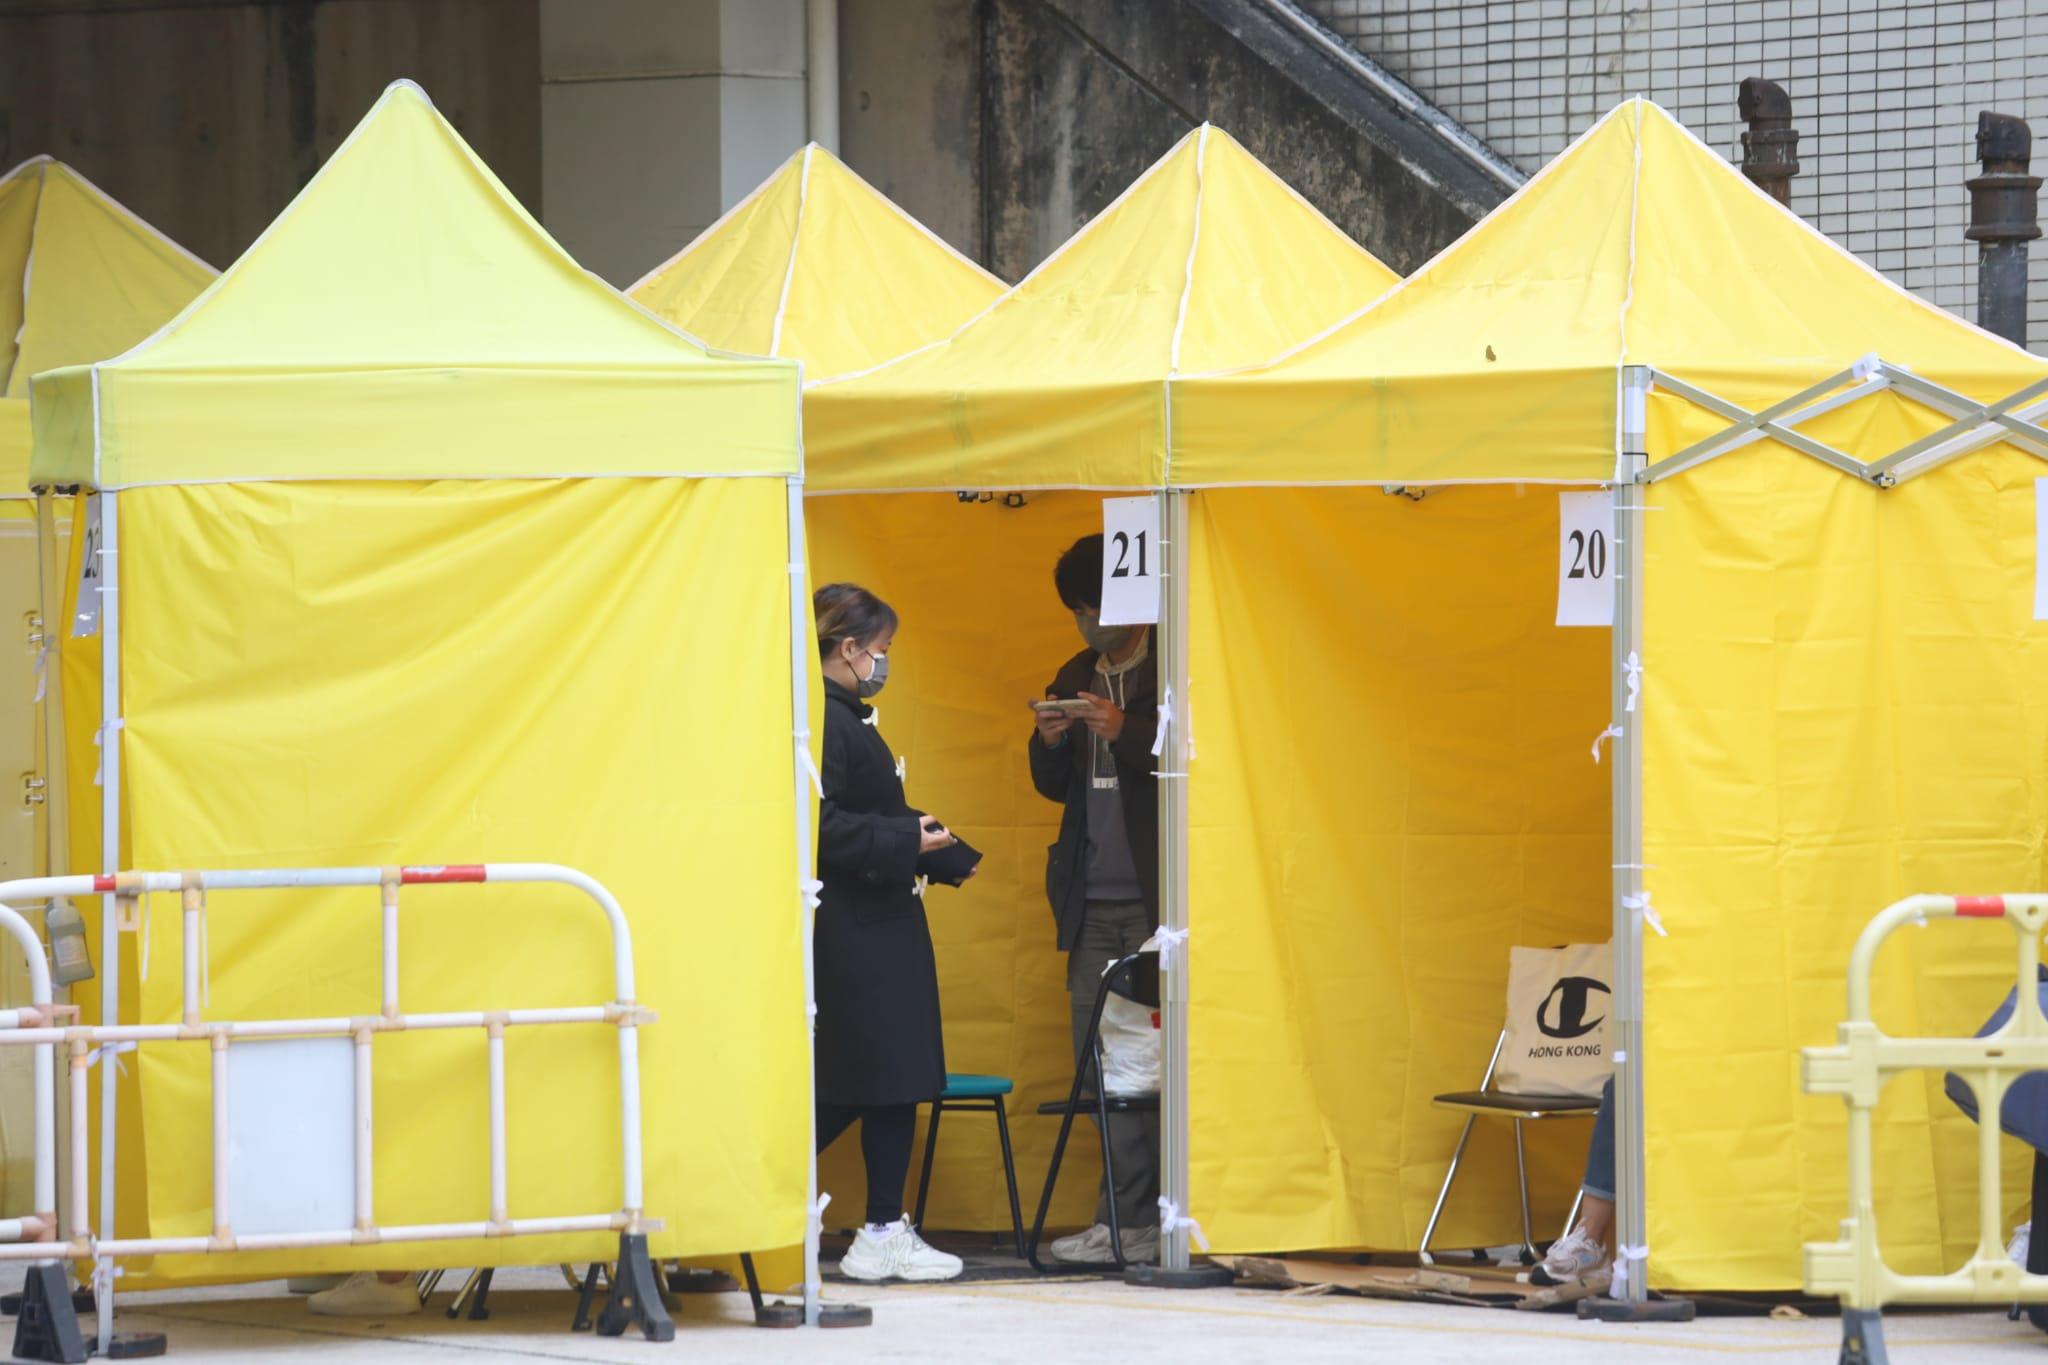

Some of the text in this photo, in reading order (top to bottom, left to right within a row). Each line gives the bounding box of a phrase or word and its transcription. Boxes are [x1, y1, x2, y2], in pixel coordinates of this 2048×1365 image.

[1111, 530, 1149, 578] 21
[1567, 529, 1606, 579] 20
[1528, 1044, 1601, 1058] HONG KONG
